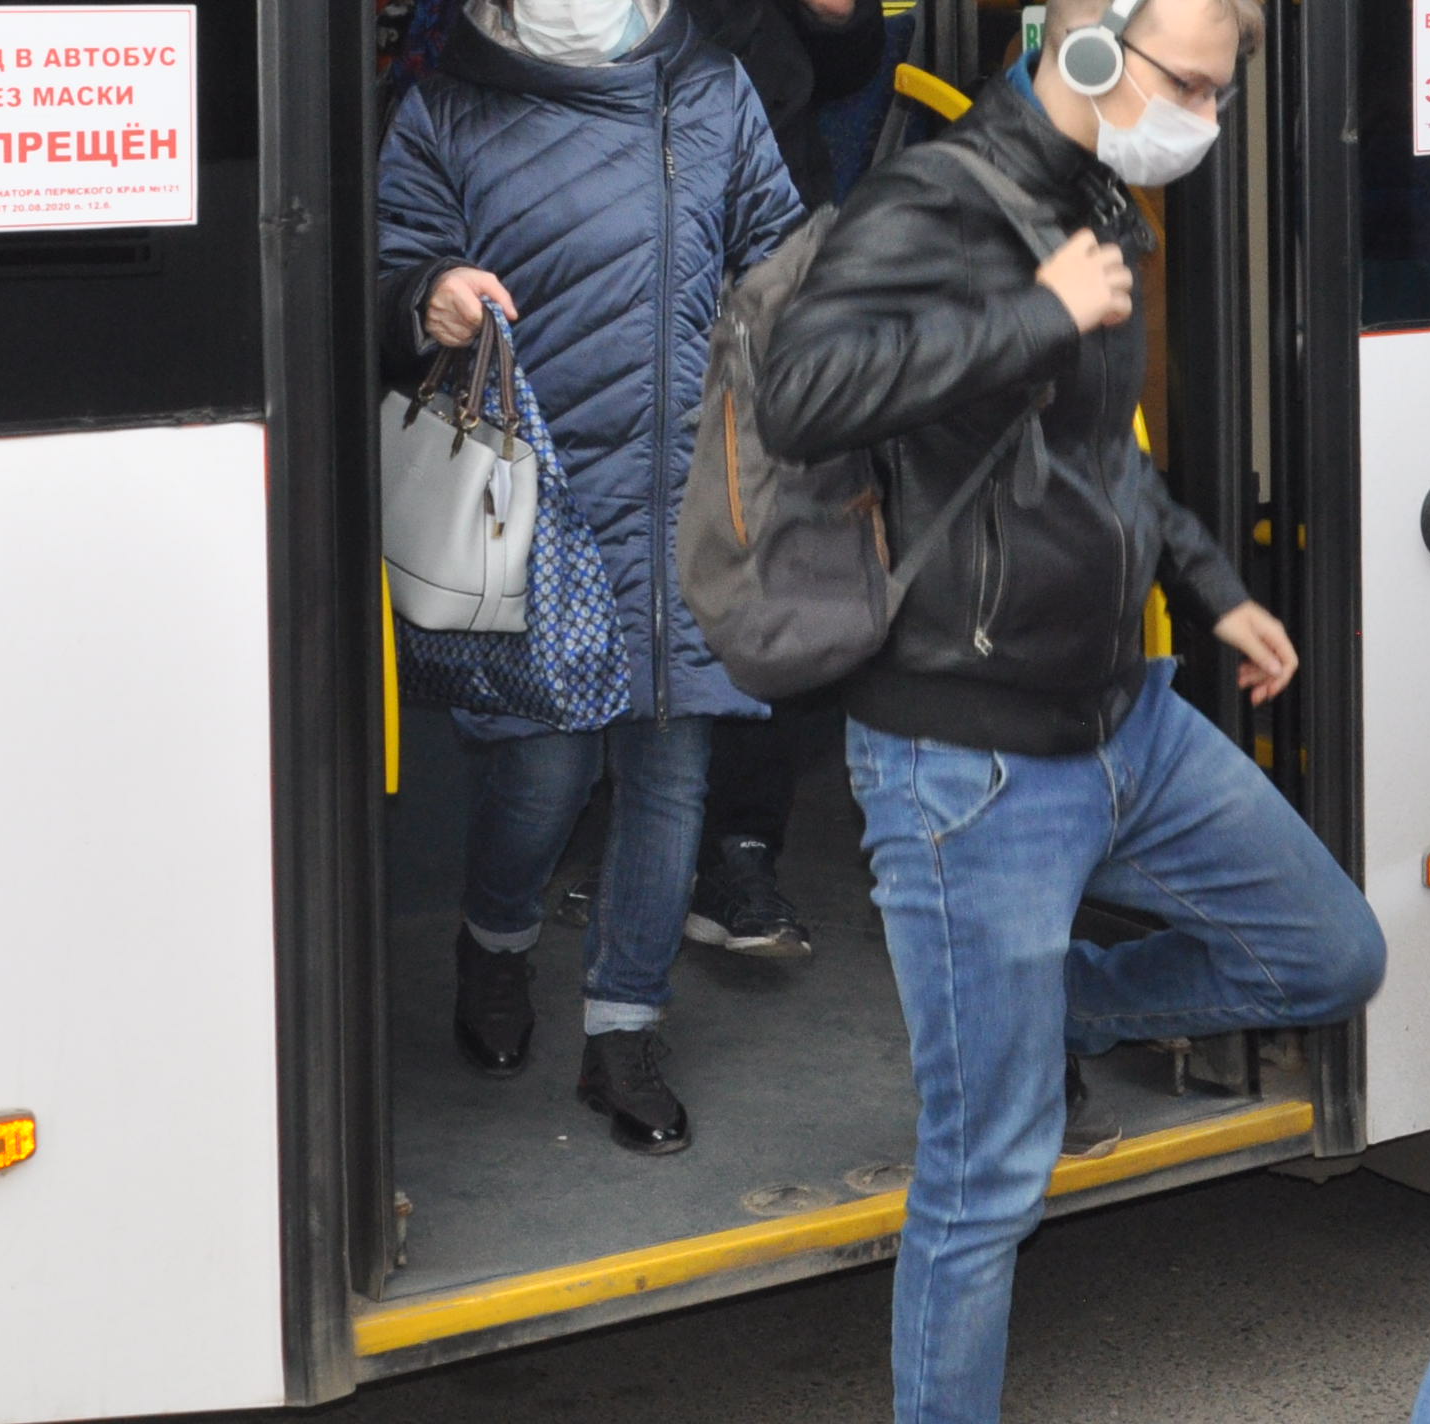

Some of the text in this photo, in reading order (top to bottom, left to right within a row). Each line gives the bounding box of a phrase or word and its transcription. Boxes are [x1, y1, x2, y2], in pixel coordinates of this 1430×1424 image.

[16, 49, 32, 68] В
[44, 47, 176, 68] АВТОБУС
[33, 86, 134, 106] МАСКИ
[45, 185, 113, 196] ПЕРМСКОГО
[117, 185, 145, 195] КРАЯ
[12, 202, 71, 214] 20.08.2020
